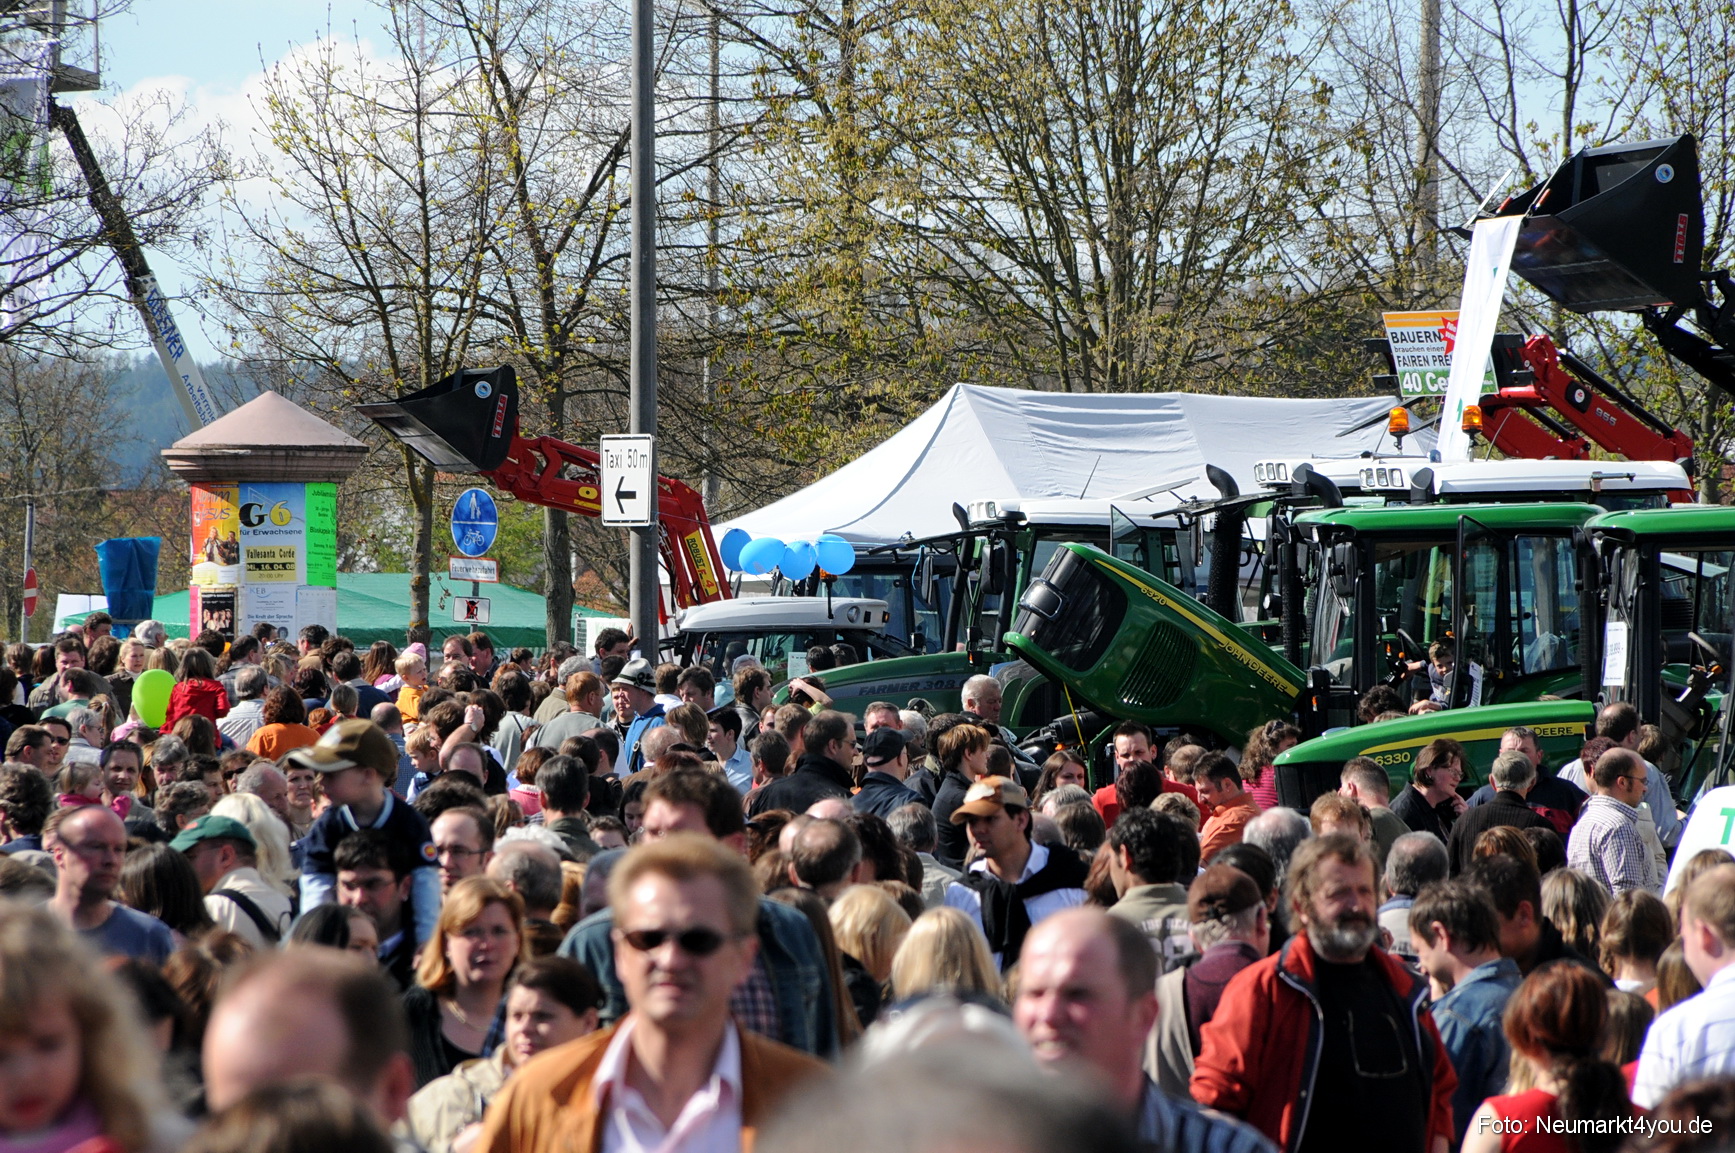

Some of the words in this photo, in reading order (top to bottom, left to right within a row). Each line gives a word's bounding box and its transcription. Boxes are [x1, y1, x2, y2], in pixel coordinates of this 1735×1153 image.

[1674, 215, 1688, 262] STOLL
[1390, 330, 1443, 343] BAUERN
[1394, 345, 1425, 353] brauchen
[1426, 345, 1445, 353] einen
[1396, 355, 1431, 367] FAIREN
[1403, 372, 1422, 393] 40
[1425, 372, 1450, 392] Ce
[492, 395, 508, 438] STOLL
[1595, 407, 1617, 427] 955
[604, 449, 624, 468] Taxi
[239, 500, 293, 527] G6
[252, 528, 303, 536] Erwachsene
[246, 549, 276, 559] Vallesanta
[687, 537, 706, 568] ROBUST
[706, 579, 714, 588] 4
[249, 587, 266, 595] KEB
[1140, 587, 1167, 605] 6320
[1218, 641, 1250, 666] JOHN
[1249, 661, 1288, 693] DEERE
[858, 682, 920, 697] FARMER
[923, 680, 956, 690] 308
[1535, 726, 1574, 737] DEERE
[1375, 751, 1411, 767] 6330
